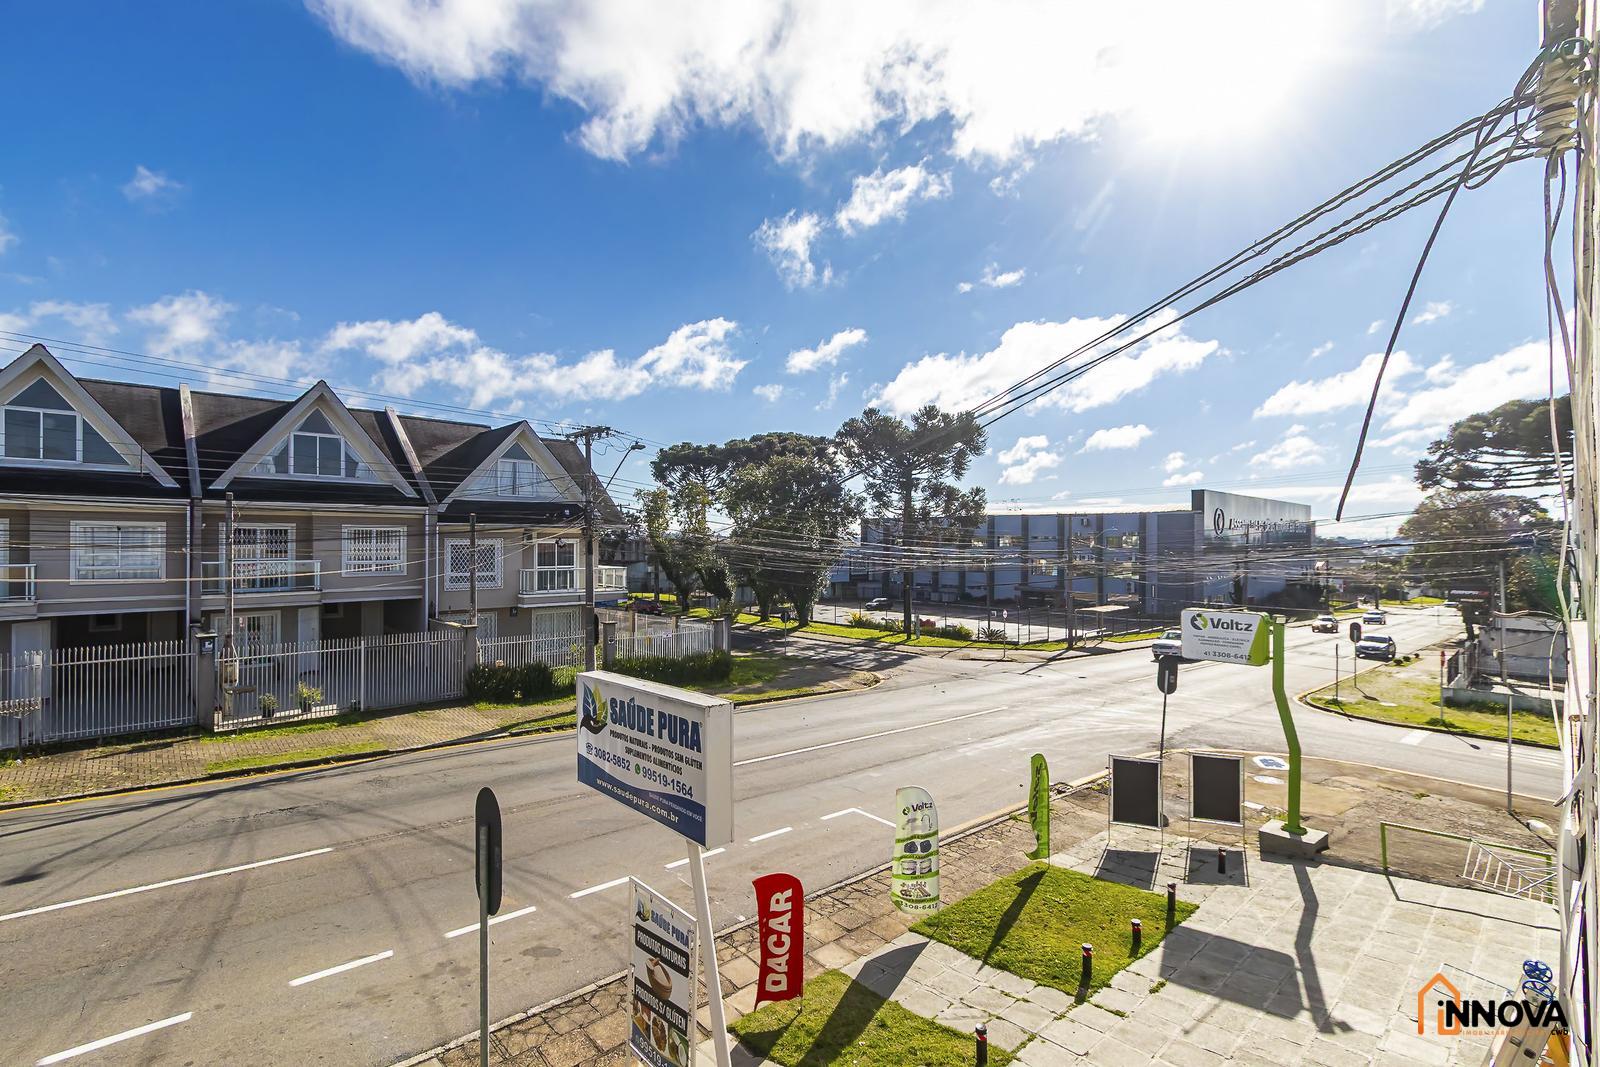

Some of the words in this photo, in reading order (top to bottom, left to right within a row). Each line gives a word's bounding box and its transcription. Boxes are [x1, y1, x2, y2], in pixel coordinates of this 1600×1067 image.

[1209, 617, 1253, 632] Voltz
[1212, 650, 1253, 661] 3308-6412
[609, 695, 655, 737] SAÚDE
[657, 710, 702, 754] PURA
[609, 729, 629, 743] PRODUTOS
[629, 735, 649, 750] NATURAIS
[651, 743, 674, 760] PRODUTOS
[674, 751, 685, 764] SEM
[684, 755, 703, 771] GLÚTEN
[624, 746, 652, 764] SUPLEMENTOS
[652, 756, 683, 776] ALIMENTÍCIOS
[593, 745, 631, 772] 3082-5852
[641, 766, 694, 798] 99519-1564
[596, 778, 680, 823] www.saudepura.com.br
[911, 801, 933, 812] Voltz
[636, 930, 661, 955] PRODUTOS
[661, 944, 687, 970] NATURAIS
[650, 910, 671, 935] SAÚDE
[671, 924, 689, 949] PURA
[765, 888, 793, 992] DACAR
[635, 983, 659, 1011] PRODUTOS
[666, 1006, 687, 1031] GLÚTEN
